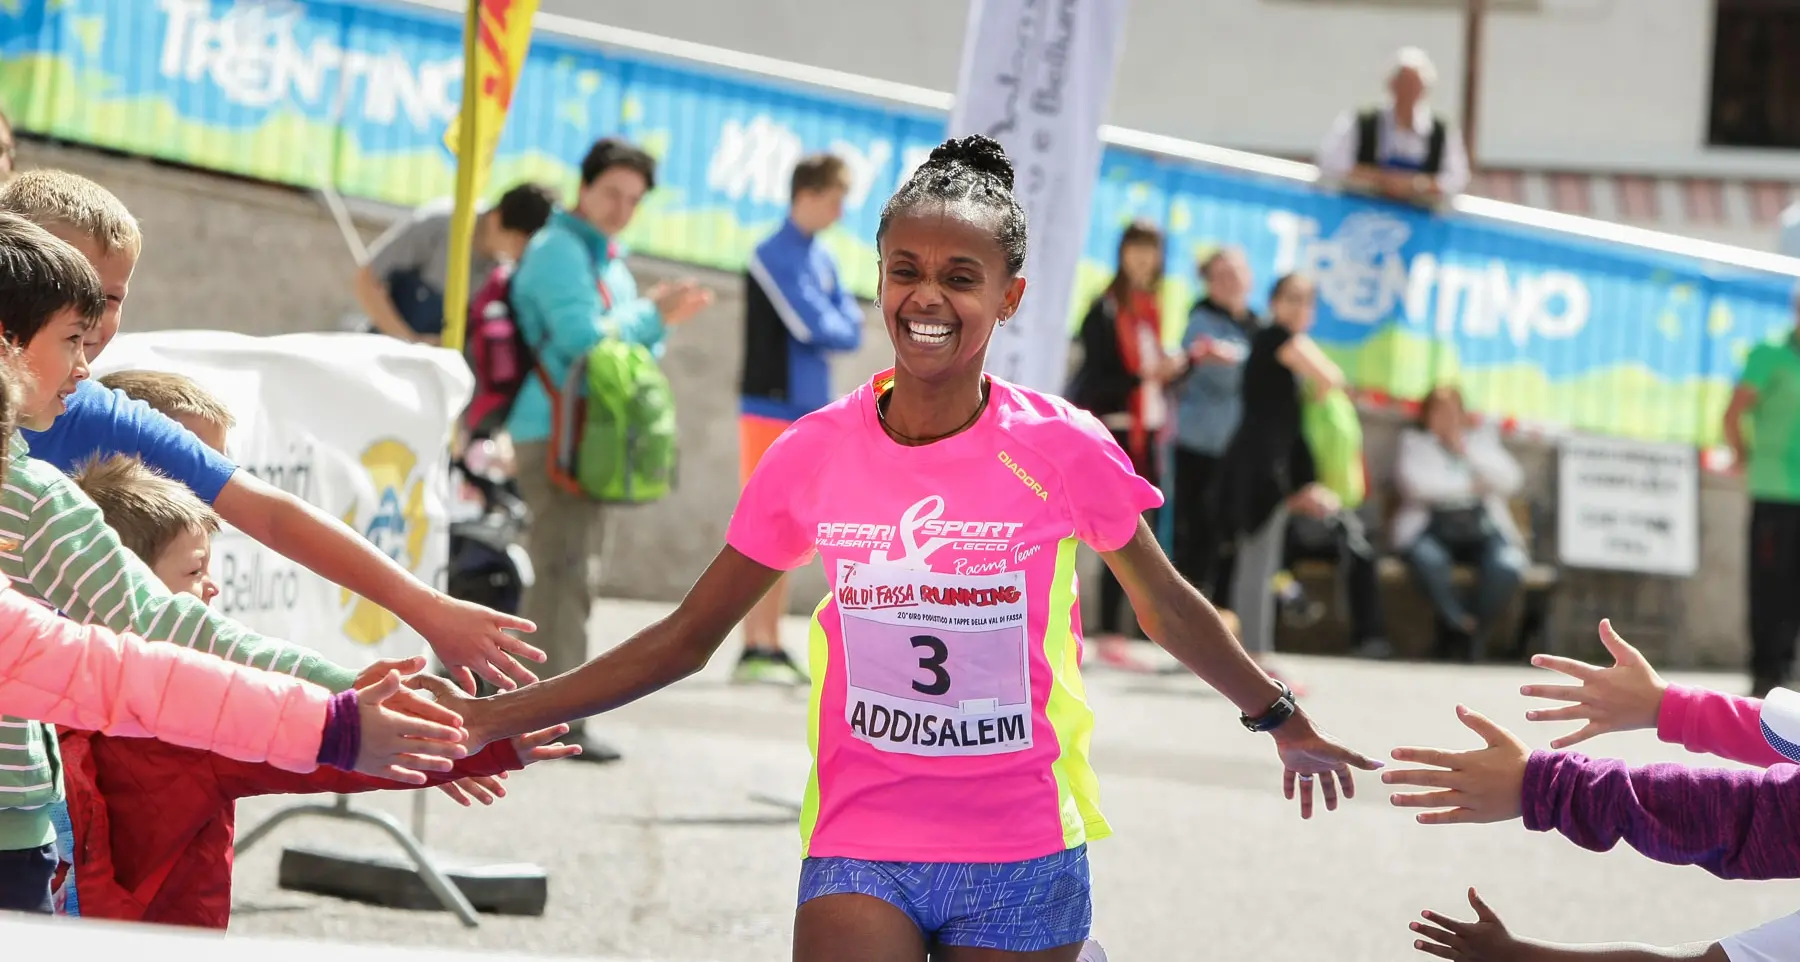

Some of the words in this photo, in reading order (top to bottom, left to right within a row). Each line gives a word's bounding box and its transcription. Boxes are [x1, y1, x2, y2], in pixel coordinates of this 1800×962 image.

[997, 450, 1048, 502] DIADORA
[816, 522, 897, 541] AFFARI
[921, 520, 1024, 538] SPORT
[814, 537, 892, 550] VILLASANTA
[952, 541, 1008, 551] LECCO
[953, 557, 1007, 576] Racing
[1010, 541, 1041, 565] Team
[876, 583, 915, 606] FASSA
[919, 584, 1021, 607] RUNNING
[909, 612, 921, 620] GIRO
[922, 613, 948, 624] PODISTICO
[949, 617, 953, 625] A
[954, 617, 970, 626] TAPPE
[971, 617, 988, 626] DELLA
[989, 616, 998, 625] VAL
[999, 615, 1005, 623] DI
[1006, 613, 1022, 622] FASSA
[909, 635, 951, 696] 3
[851, 701, 1026, 747] ADDISALEM
